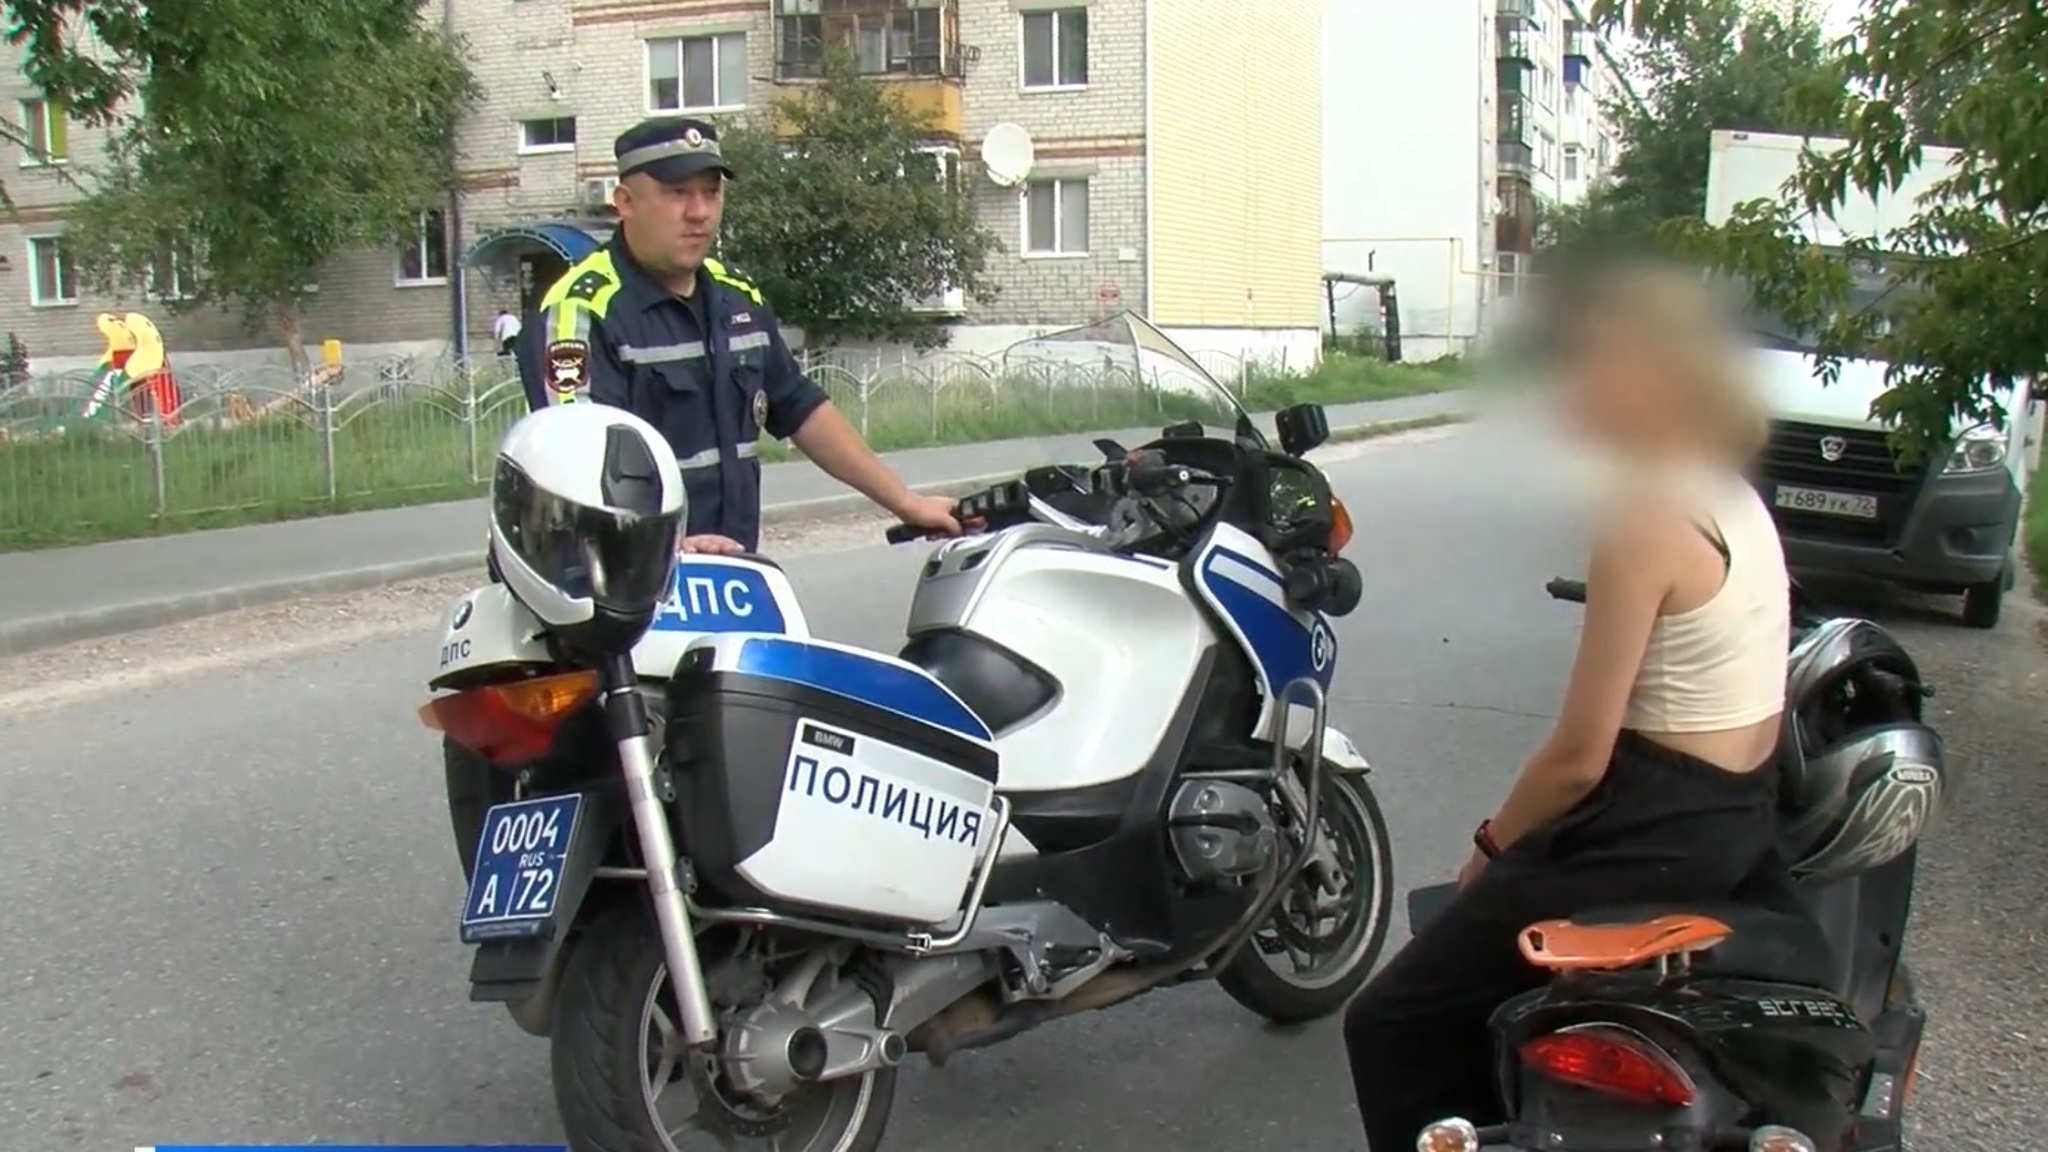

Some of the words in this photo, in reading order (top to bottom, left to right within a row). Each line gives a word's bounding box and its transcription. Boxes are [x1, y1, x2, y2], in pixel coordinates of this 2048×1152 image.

[440, 639, 471, 669] ДПС
[814, 730, 844, 749] BMW
[789, 754, 981, 847] ПОЛИЦИЯ
[492, 808, 560, 854] 0004
[518, 852, 545, 869] RUS
[515, 868, 553, 911] 72
